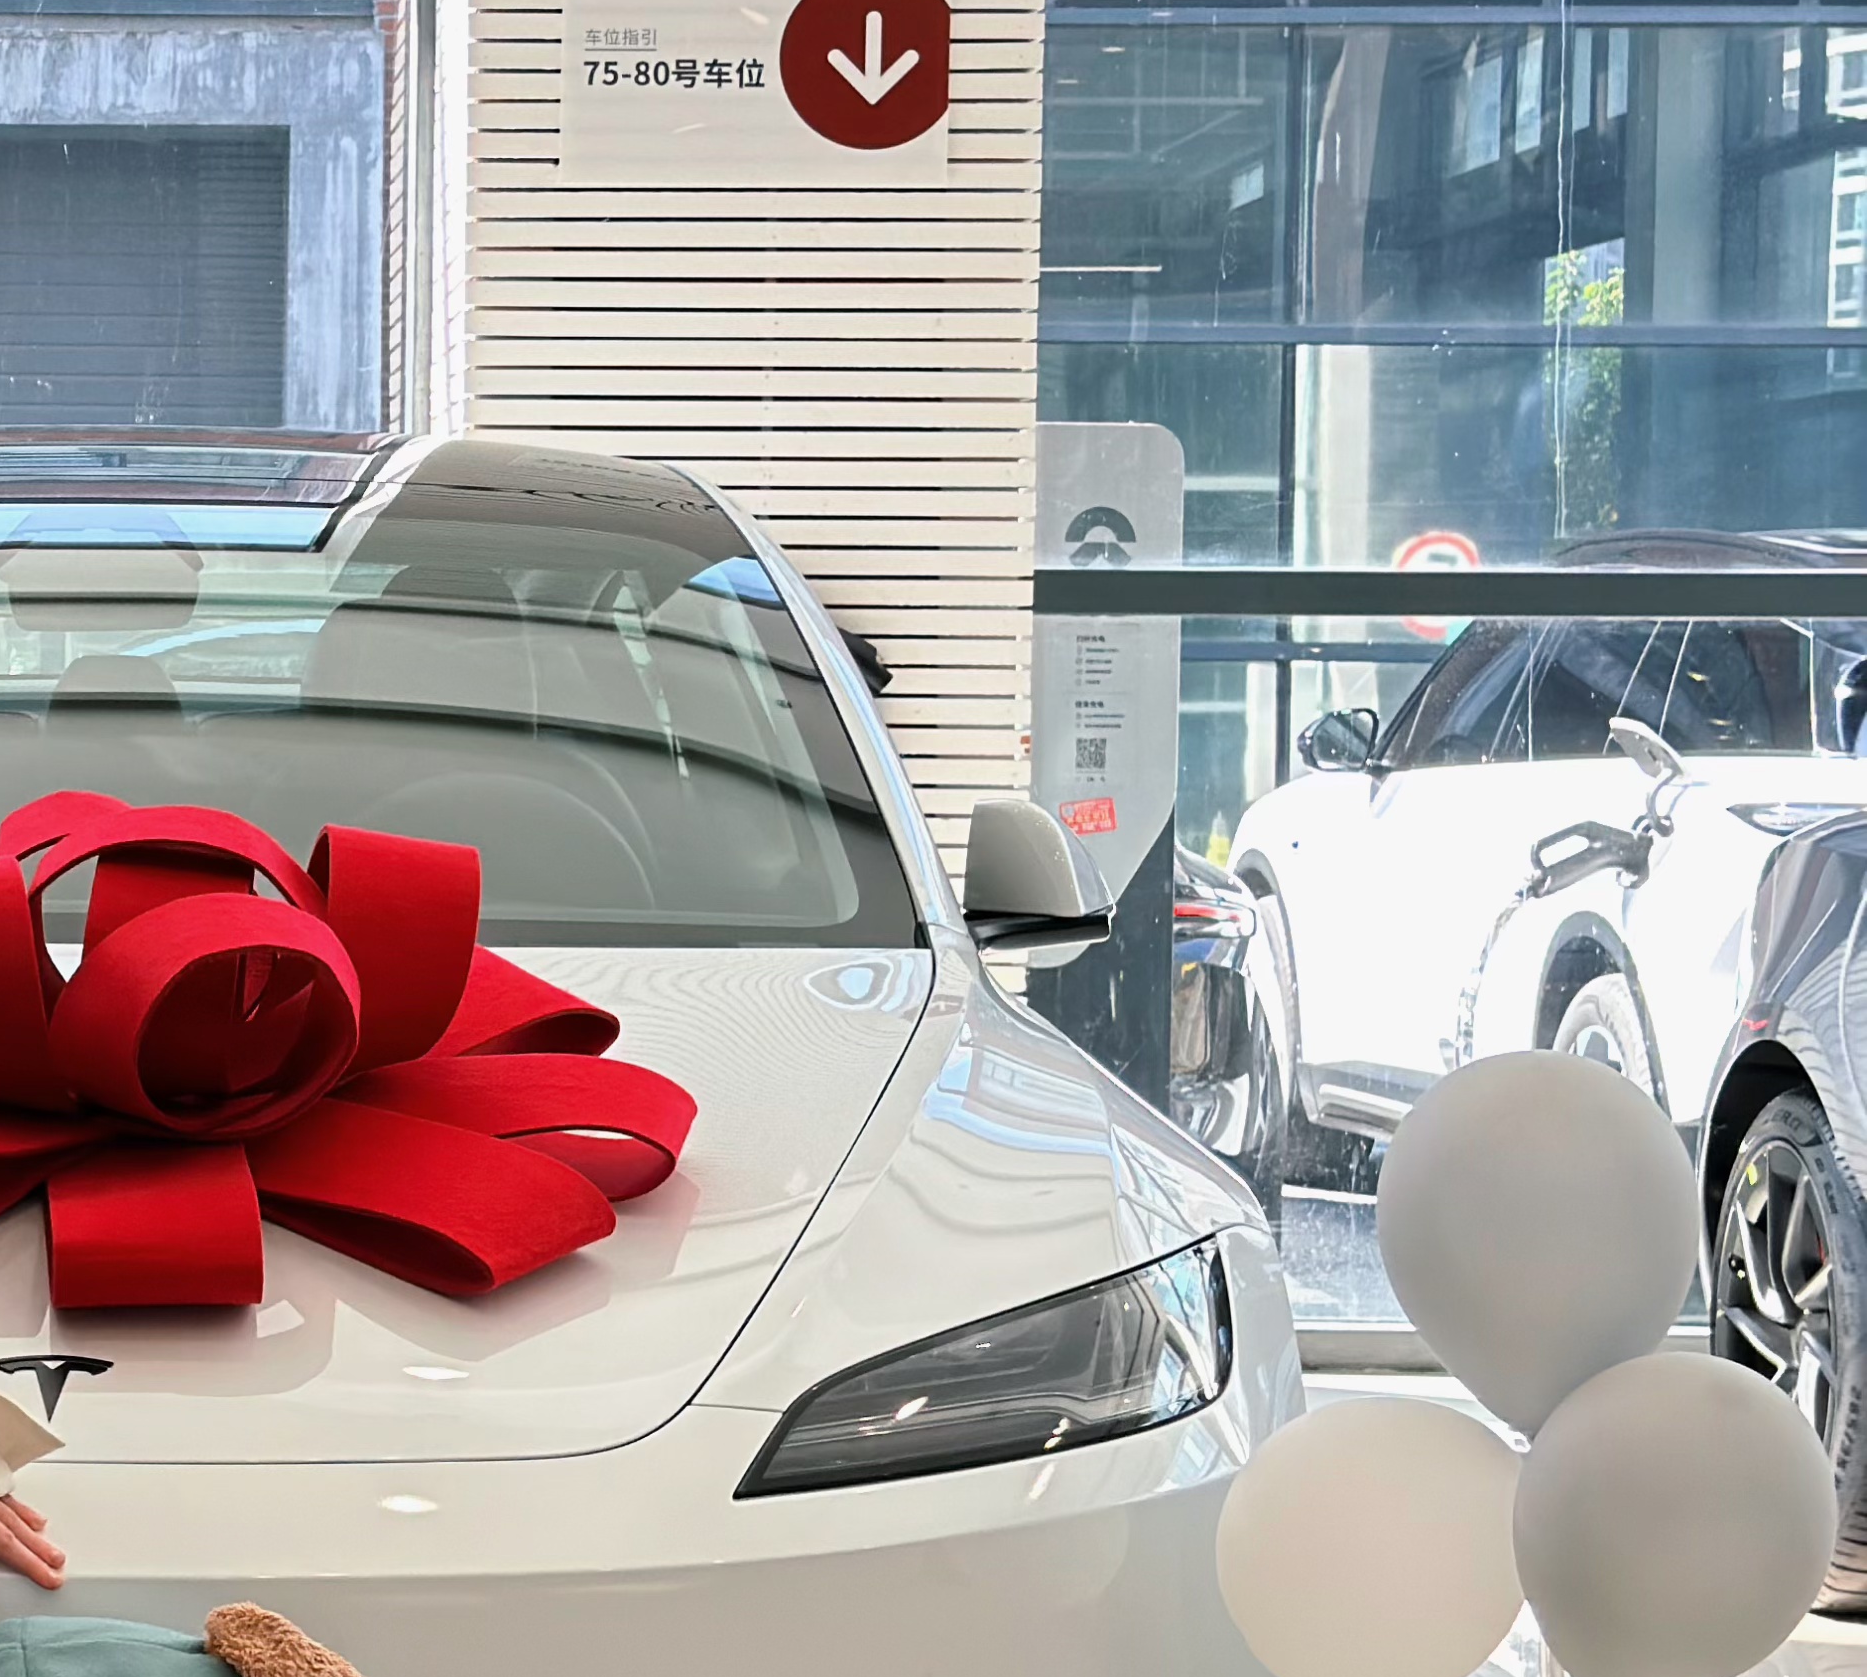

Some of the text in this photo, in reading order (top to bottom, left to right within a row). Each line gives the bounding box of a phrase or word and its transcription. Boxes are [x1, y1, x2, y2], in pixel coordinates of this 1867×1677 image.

[584, 28, 658, 47] 车位指引
[583, 58, 766, 89] 75-80号车位
